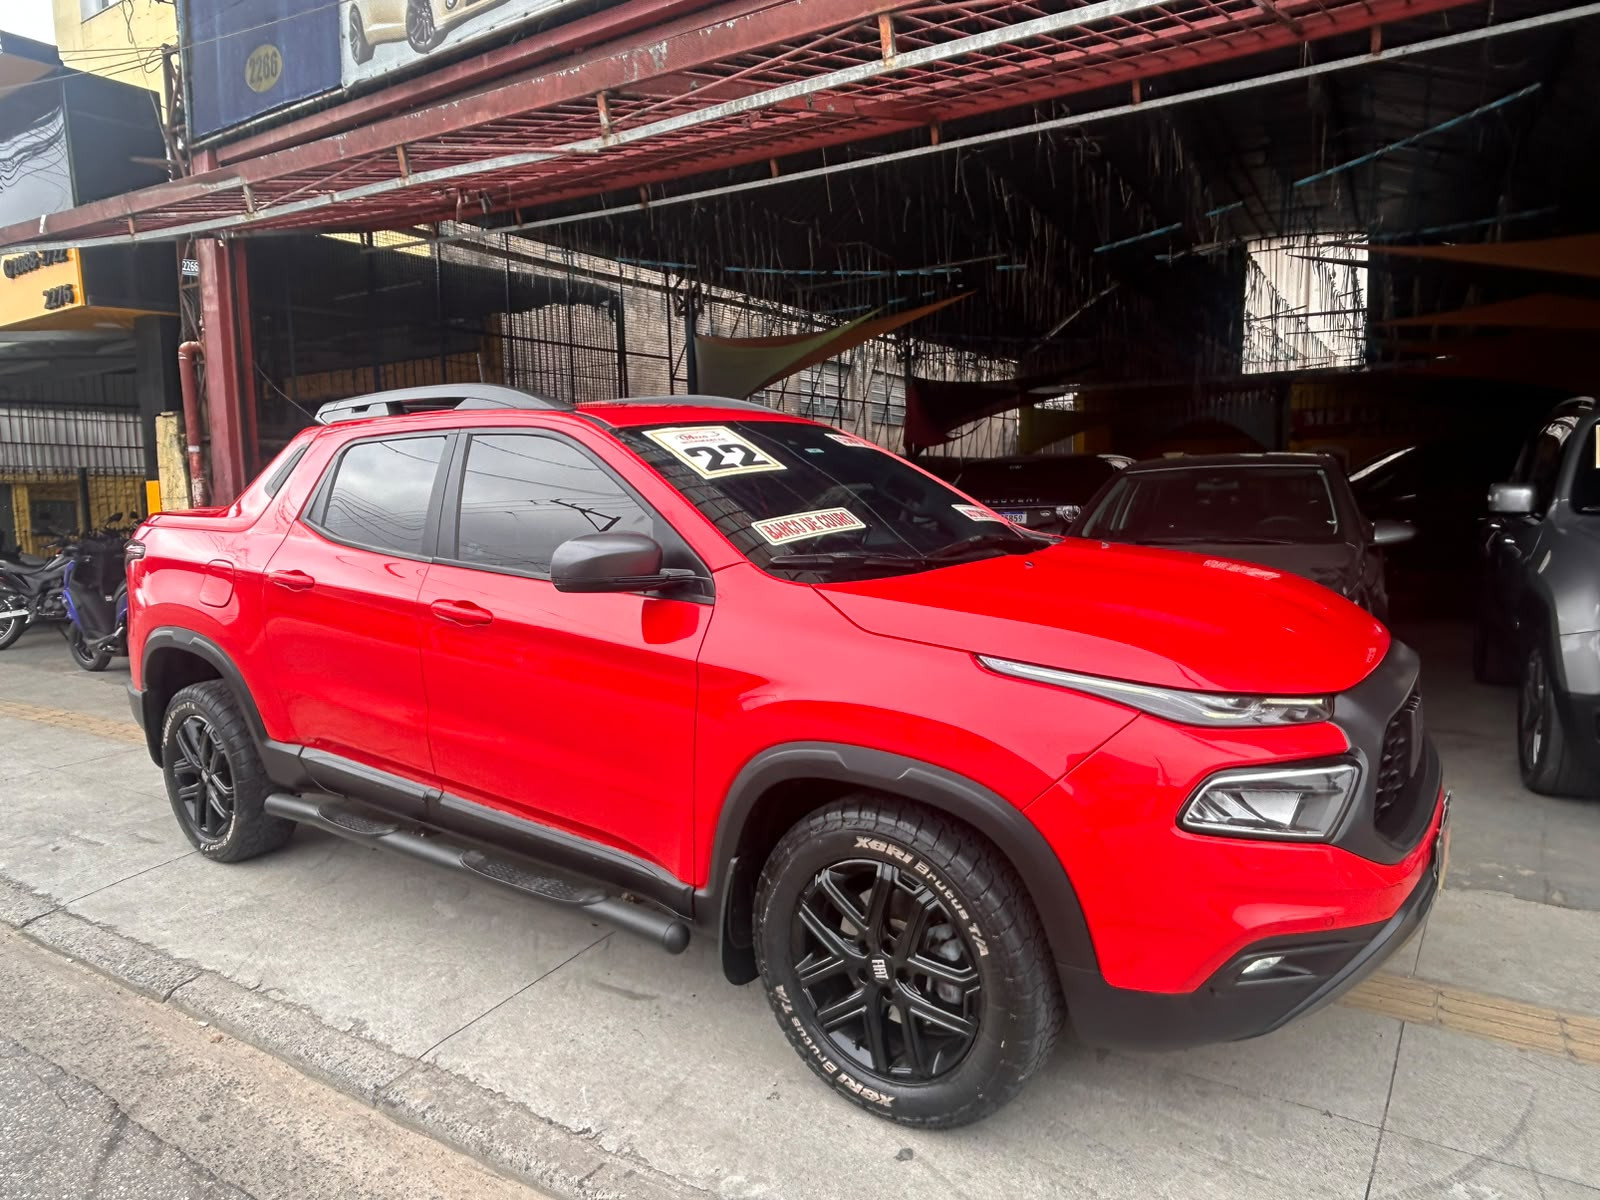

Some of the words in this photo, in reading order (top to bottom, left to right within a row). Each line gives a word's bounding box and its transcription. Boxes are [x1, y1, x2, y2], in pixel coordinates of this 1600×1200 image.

[249, 50, 278, 84] 2266
[182, 260, 199, 272] 2266
[683, 443, 772, 472] 22
[761, 519, 808, 540] BANCO
[799, 516, 822, 531] DE
[814, 511, 857, 529] COURO
[871, 959, 889, 980] FIAT
